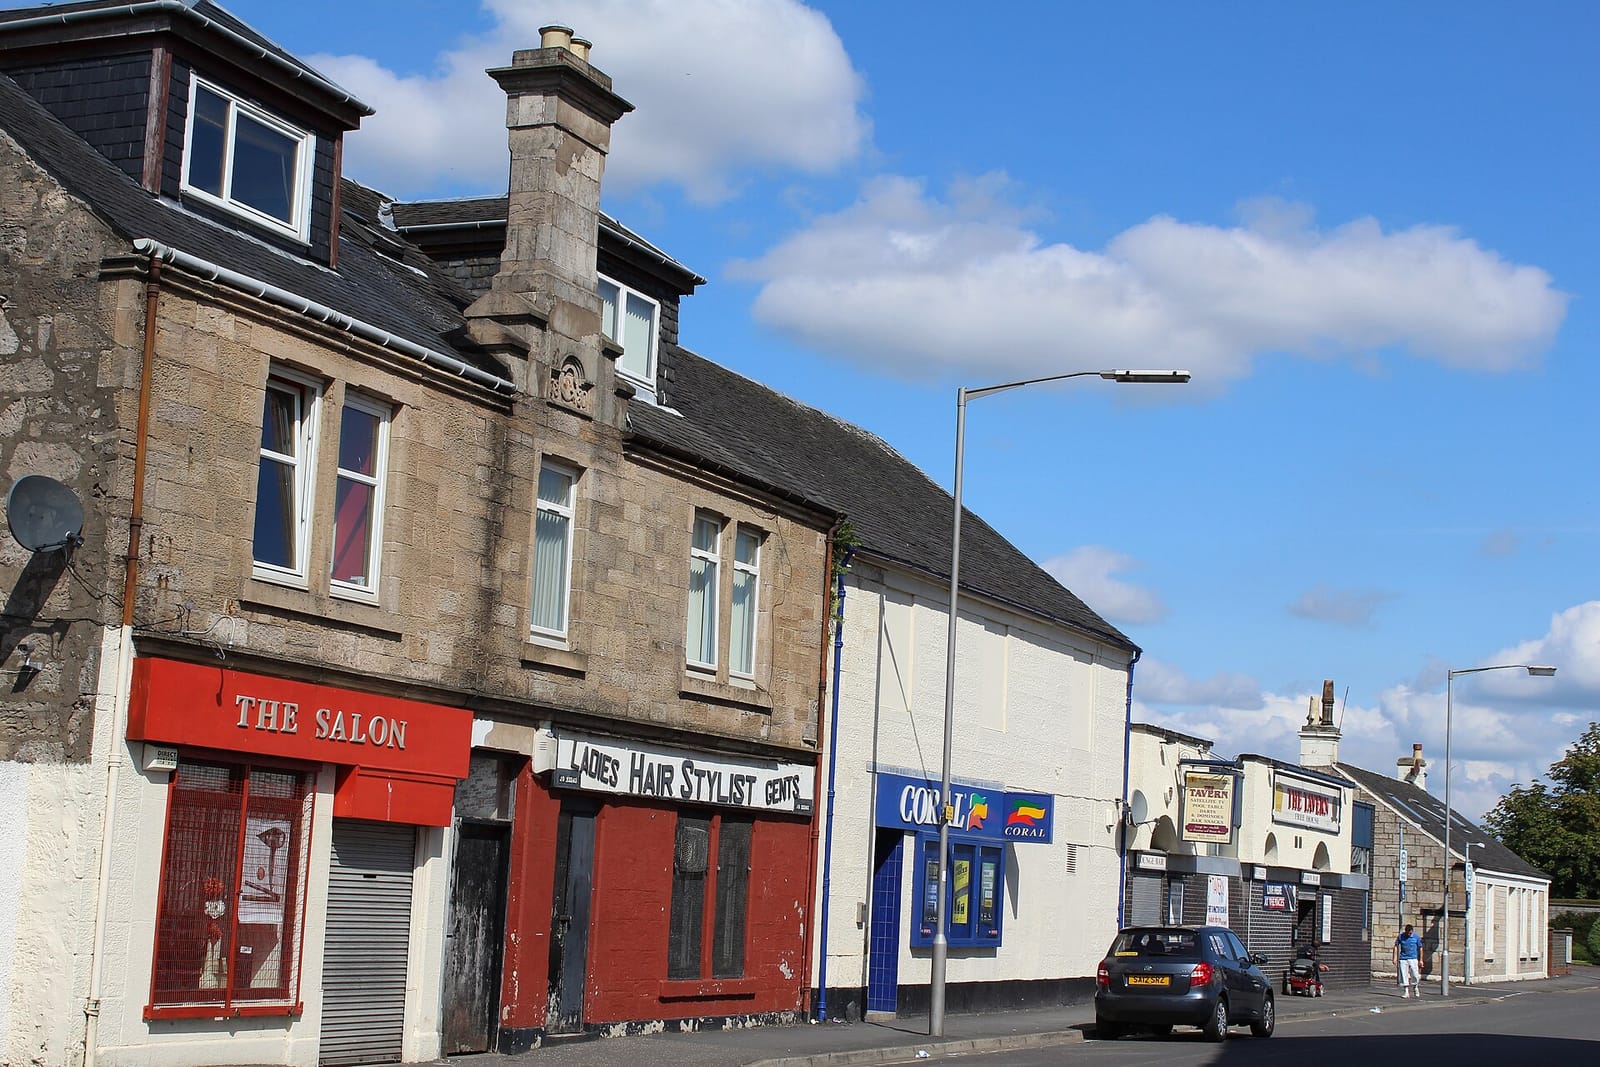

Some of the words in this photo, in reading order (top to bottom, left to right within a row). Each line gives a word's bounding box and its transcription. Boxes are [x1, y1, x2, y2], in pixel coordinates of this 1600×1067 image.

[235, 694, 299, 734] THE
[315, 708, 408, 749] SALON
[570, 740, 620, 788] LADIES
[629, 751, 674, 797] HAIR
[680, 759, 757, 806] STYLIST
[764, 774, 801, 806] GENTS
[1190, 789, 1228, 799] TAVERN
[1287, 788, 1302, 811] THE
[1304, 791, 1329, 816] TAVERN
[1004, 826, 1046, 838] CORAL
